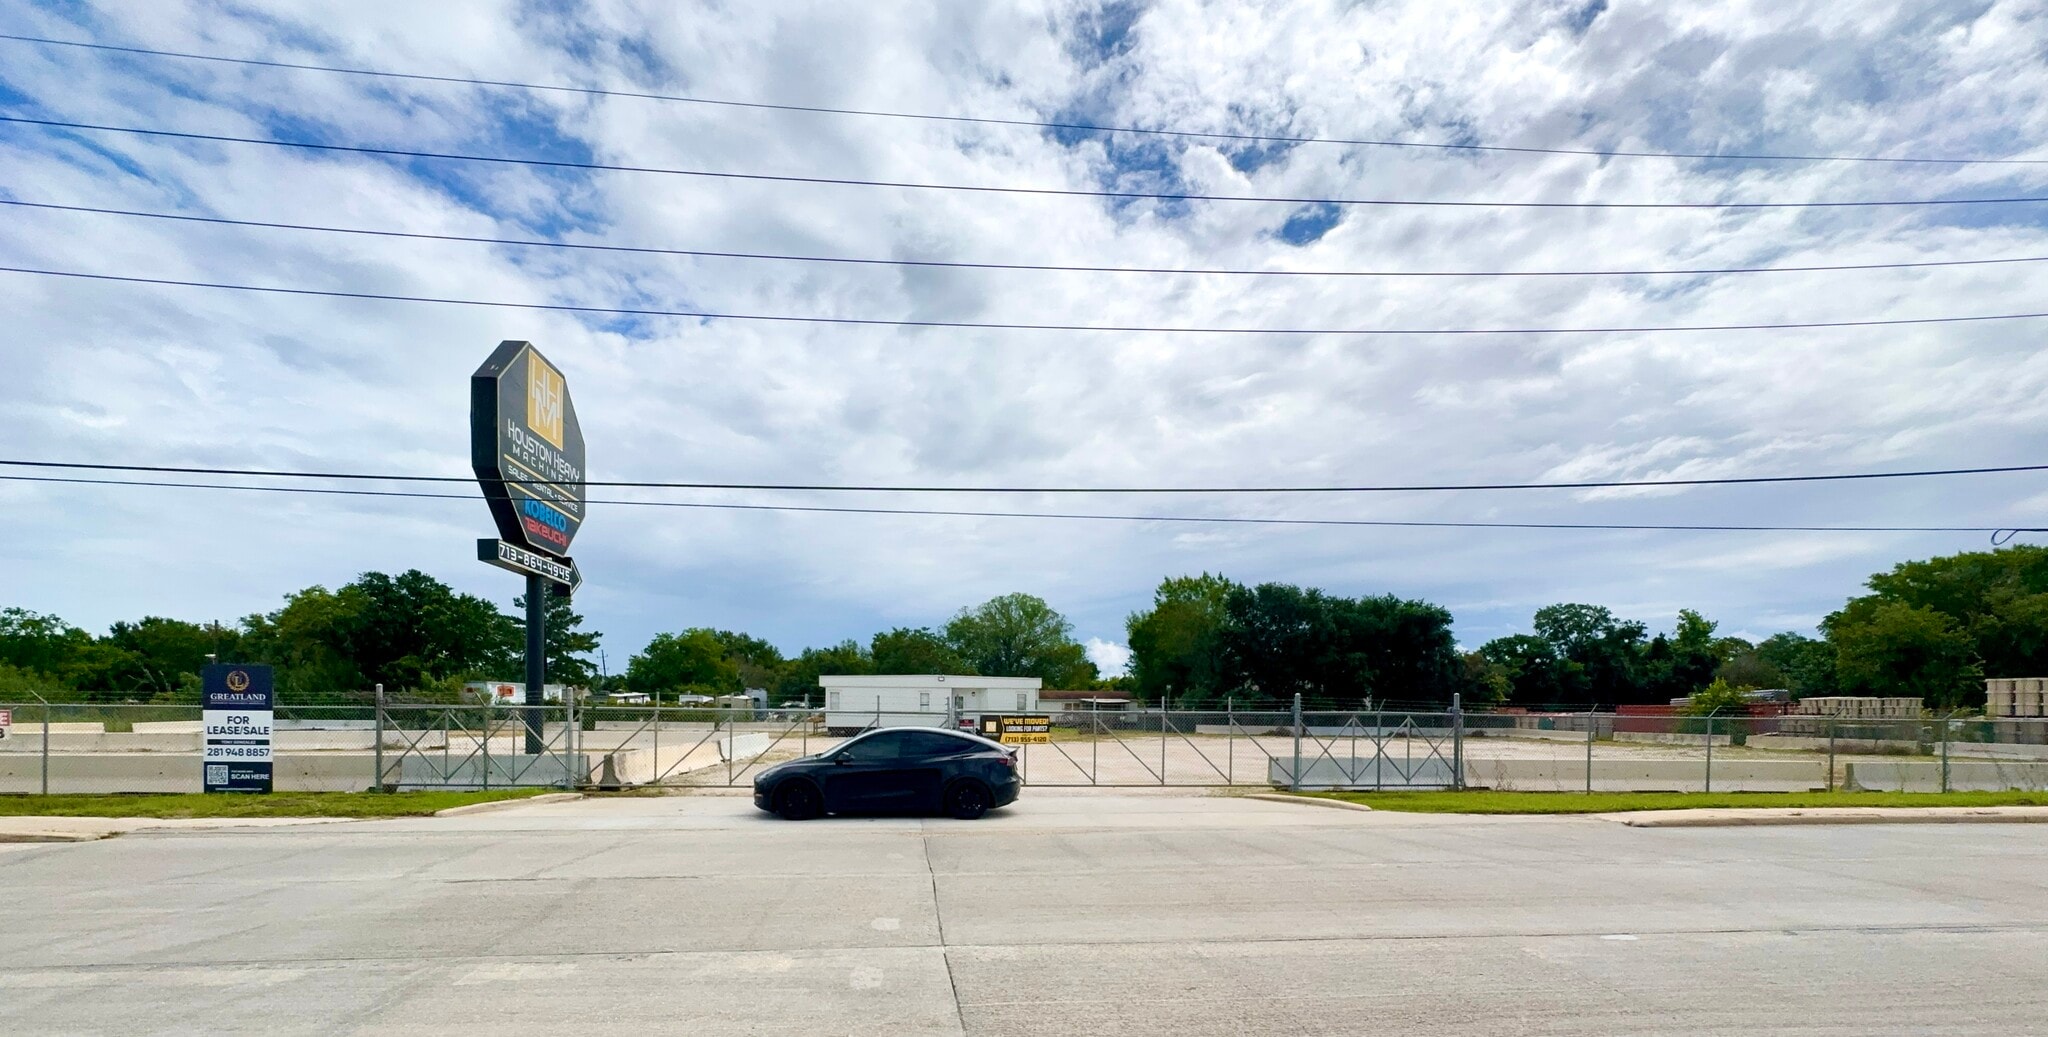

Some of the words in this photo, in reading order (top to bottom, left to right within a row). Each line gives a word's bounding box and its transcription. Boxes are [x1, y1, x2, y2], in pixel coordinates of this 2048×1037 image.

[507, 418, 552, 466] HOUSTON
[553, 451, 580, 483] HEAVY
[507, 464, 529, 482] SALES
[524, 494, 567, 532] KOBELCO
[524, 517, 568, 546] TAKEUCHI
[499, 545, 570, 581] 713-864-4945
[210, 693, 266, 701] GREATLAND
[227, 716, 250, 725] FOR
[207, 726, 270, 735] LEASE/SALE
[207, 748, 224, 756] 281
[225, 748, 244, 757] 948
[246, 748, 270, 757] 8857
